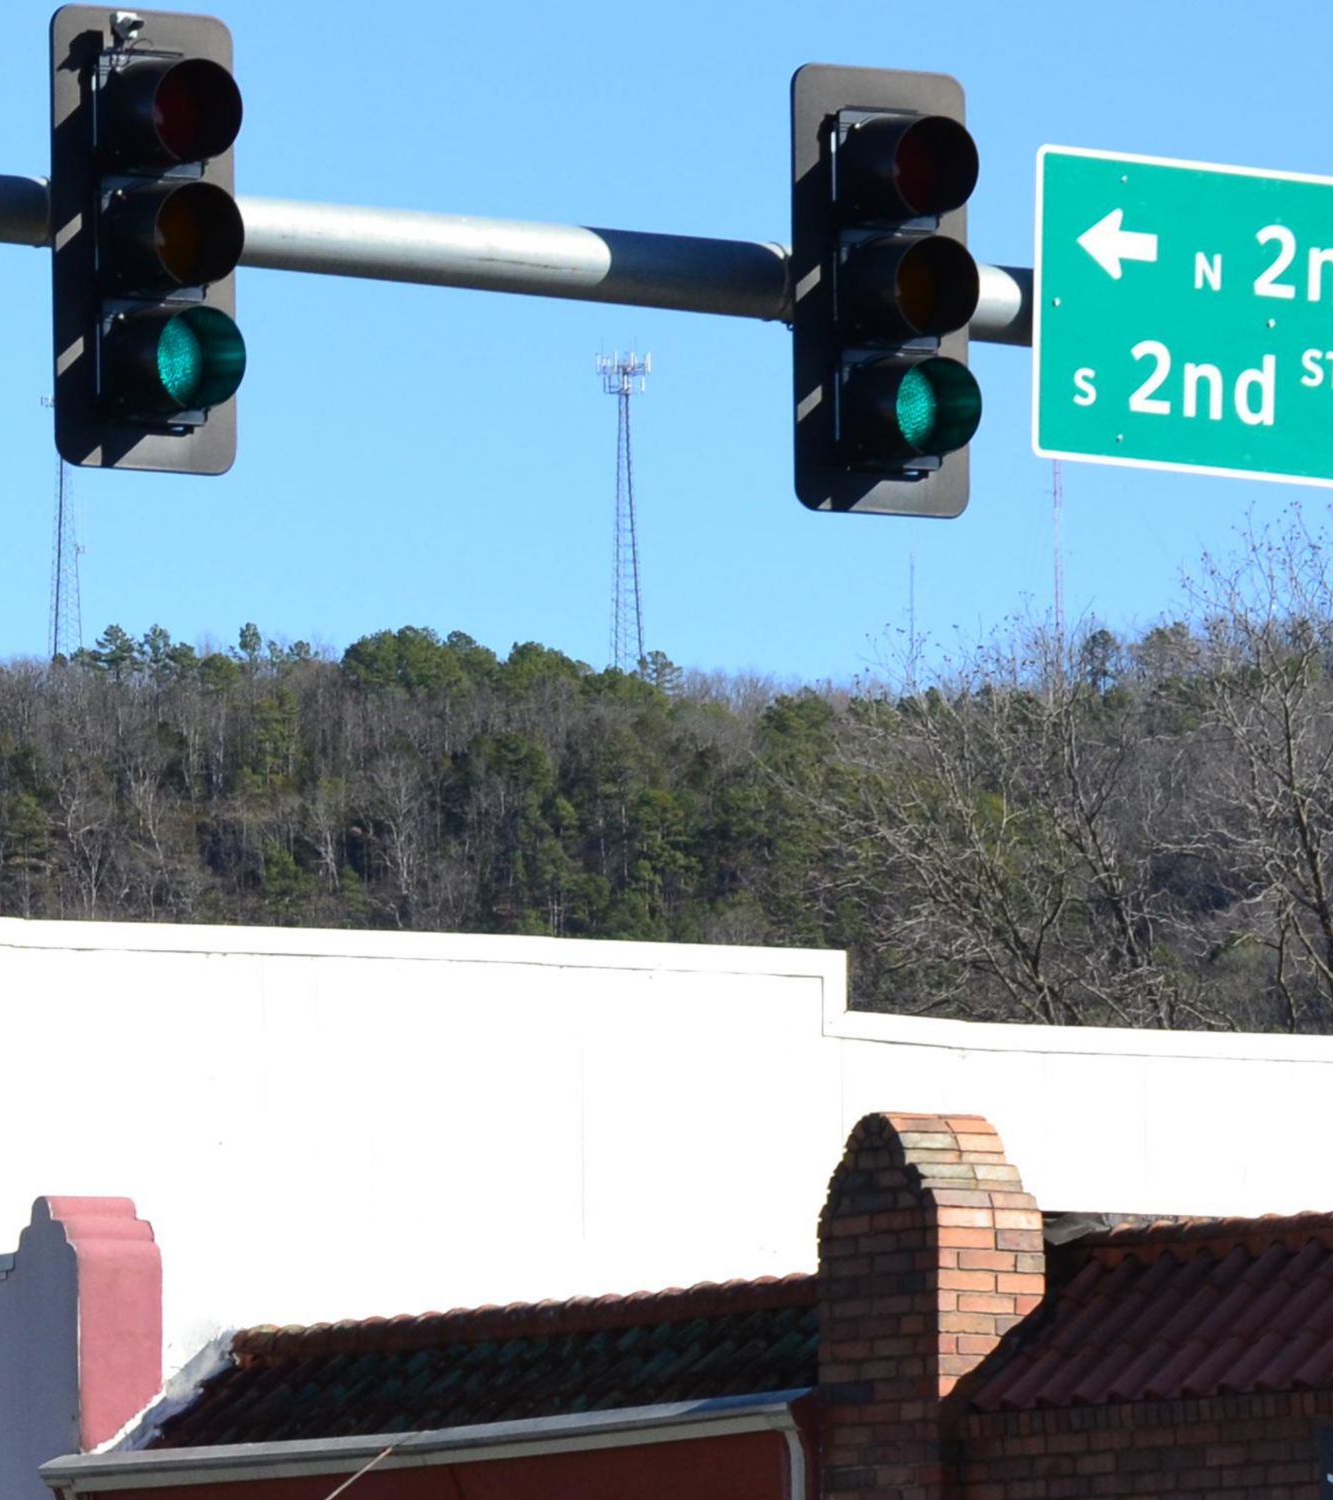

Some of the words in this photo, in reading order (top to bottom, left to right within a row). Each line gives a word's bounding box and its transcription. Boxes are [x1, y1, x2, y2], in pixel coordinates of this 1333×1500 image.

[1194, 251, 1223, 293] N
[1073, 366, 1097, 407] S
[1128, 339, 1276, 427] 2nd
